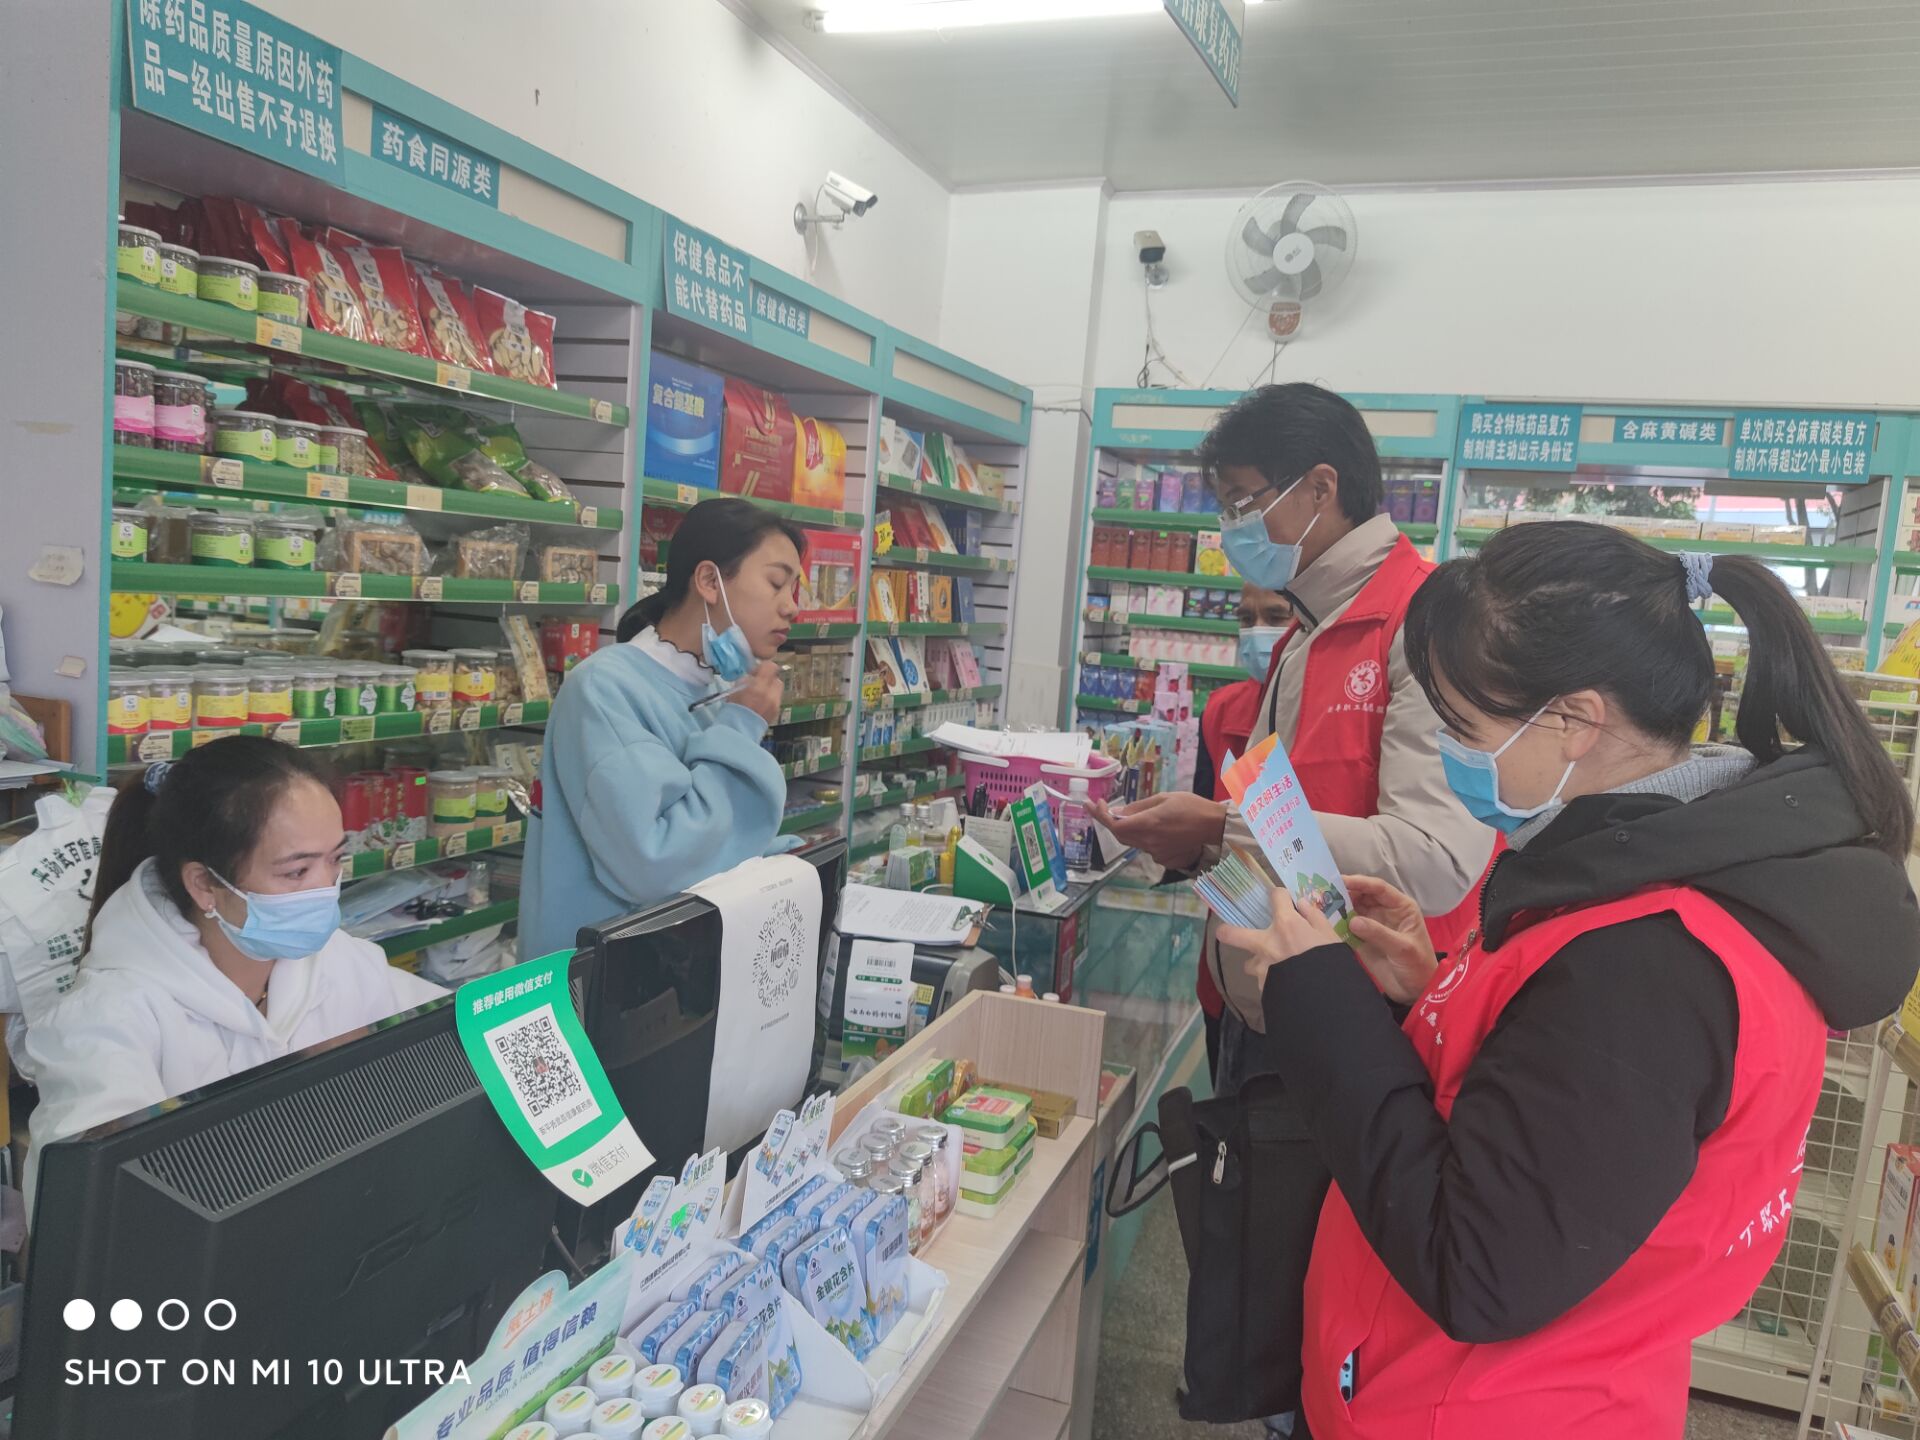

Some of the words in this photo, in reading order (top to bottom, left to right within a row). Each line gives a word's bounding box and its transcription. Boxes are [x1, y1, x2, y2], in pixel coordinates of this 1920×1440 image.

[144, 40, 338, 166] 品一经出售不予退换
[382, 120, 492, 199] 药食同源类
[673, 230, 745, 293] 保健食品不
[674, 274, 748, 333] 能代替药品
[756, 294, 806, 334] 保健食品类
[1471, 412, 1571, 436] 购买含特殊药品复方
[1621, 420, 1717, 442] 含麻黄碱类
[1740, 418, 1867, 446] 单次购买含麻黄碱类复方
[1463, 437, 1572, 463] 制剂请主动出示身份证
[1734, 447, 1866, 476] 制剂不得超过2个最小包装
[472, 971, 553, 1015] 推荐使用微信支付
[588, 1144, 630, 1177] 微信支付
[816, 1261, 855, 1302] 金银花含片
[436, 1360, 515, 1440] 专业品质
[523, 1301, 597, 1369] 值得信赖
